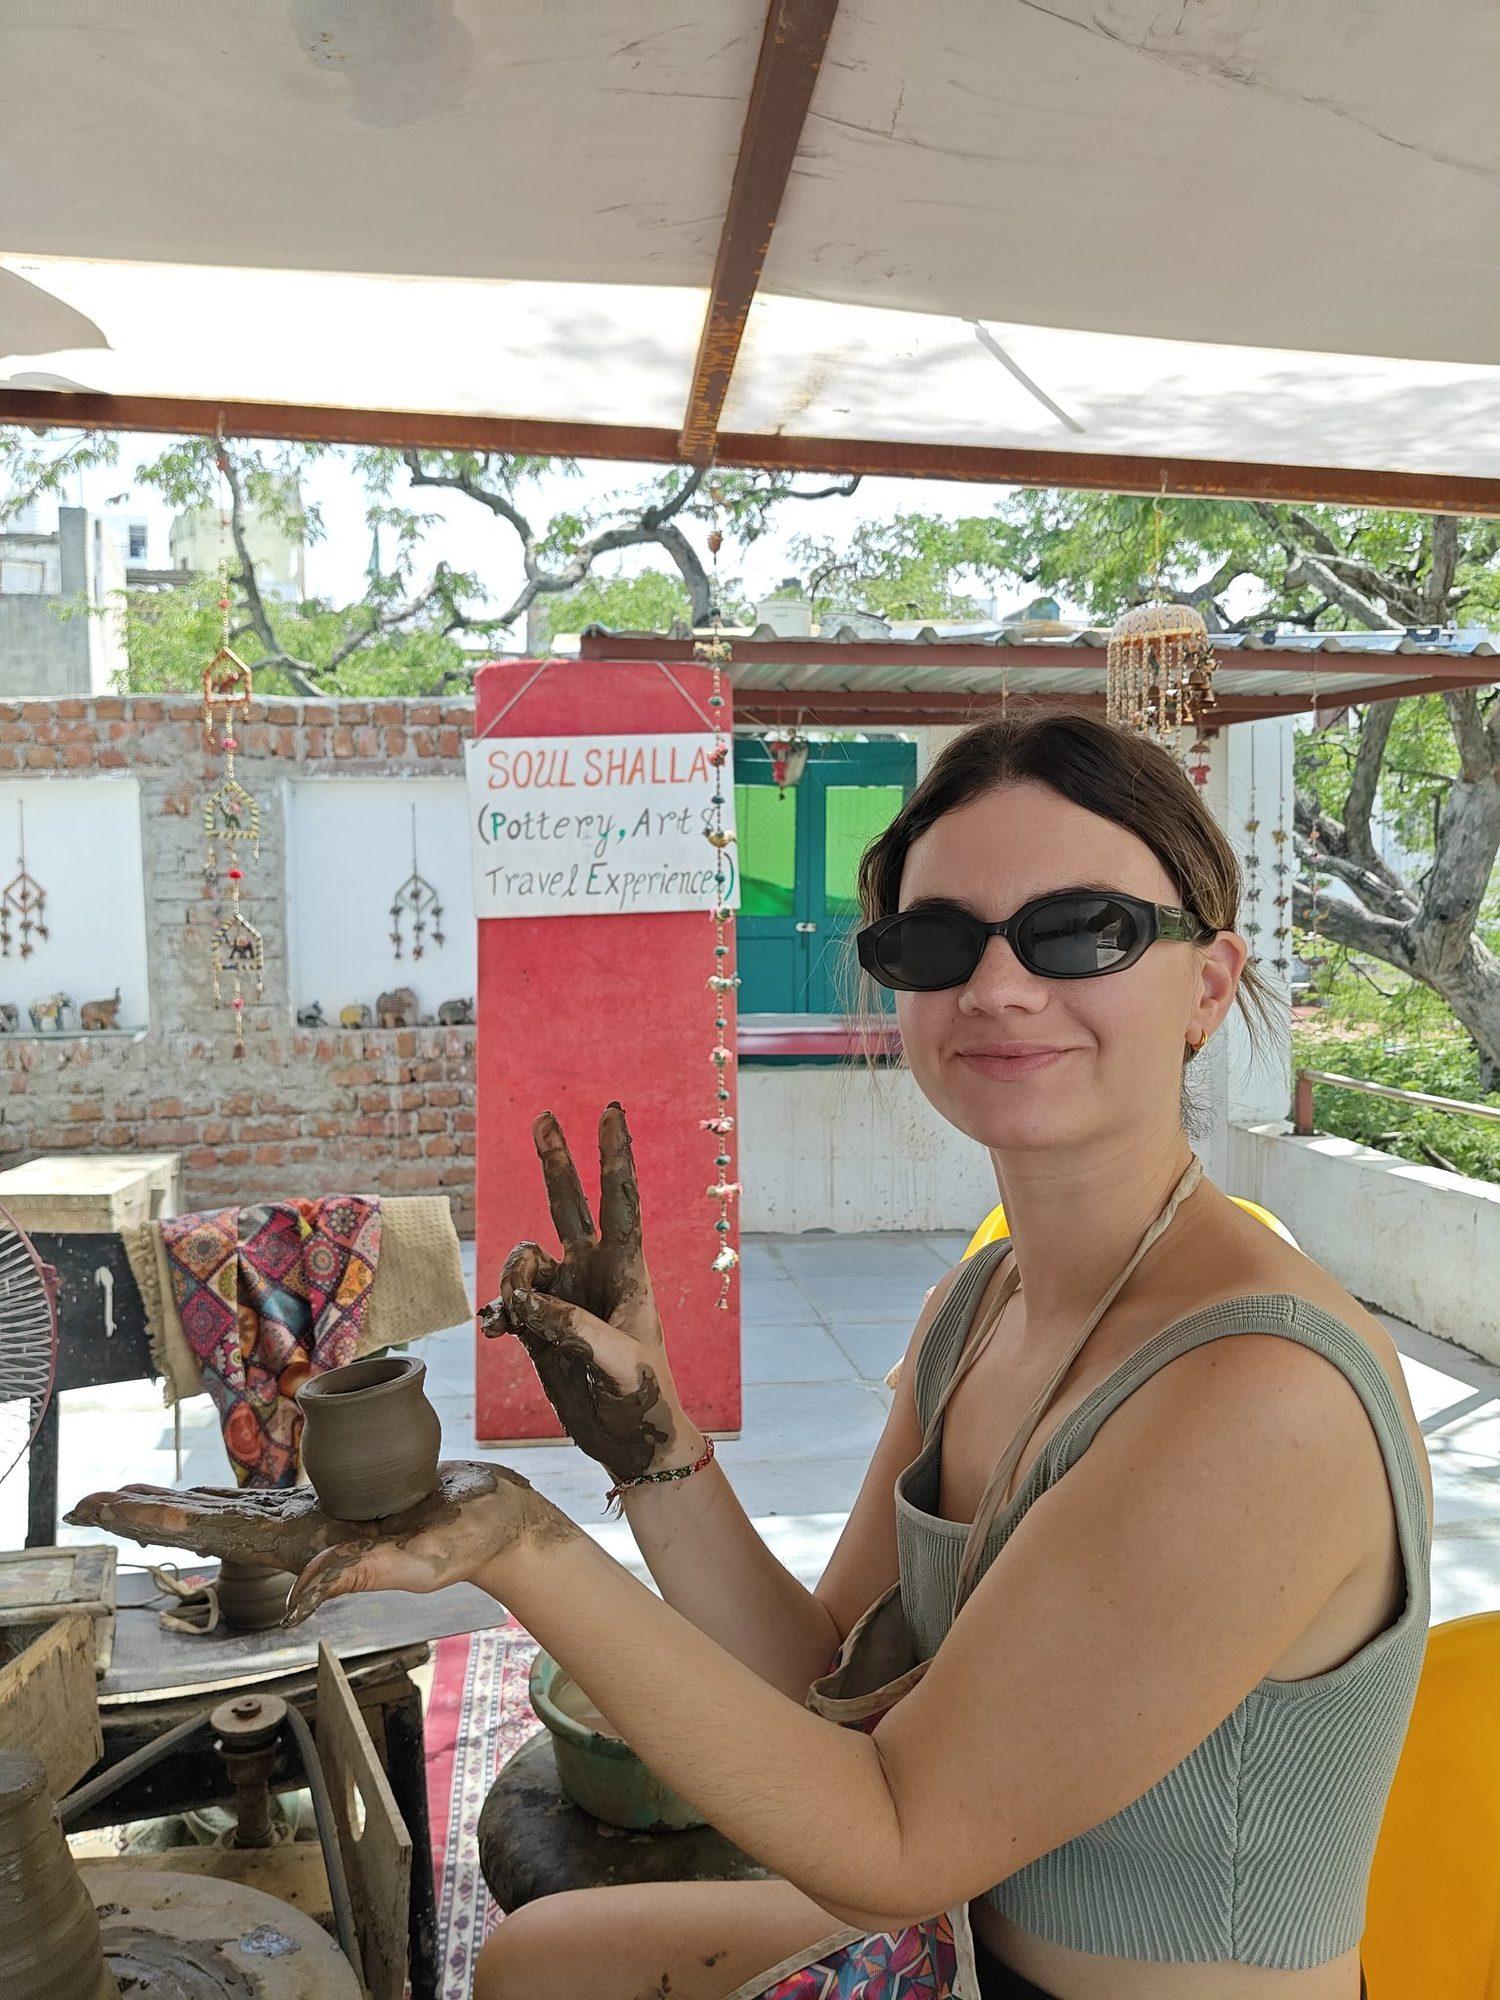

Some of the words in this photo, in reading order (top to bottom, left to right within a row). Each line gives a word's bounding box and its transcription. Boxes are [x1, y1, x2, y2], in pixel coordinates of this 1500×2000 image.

[487, 749, 576, 789] SOUL
[583, 746, 709, 786] SHALLA
[477, 803, 626, 858] (Pottery,
[630, 807, 692, 838] Art
[485, 863, 579, 898] Travel
